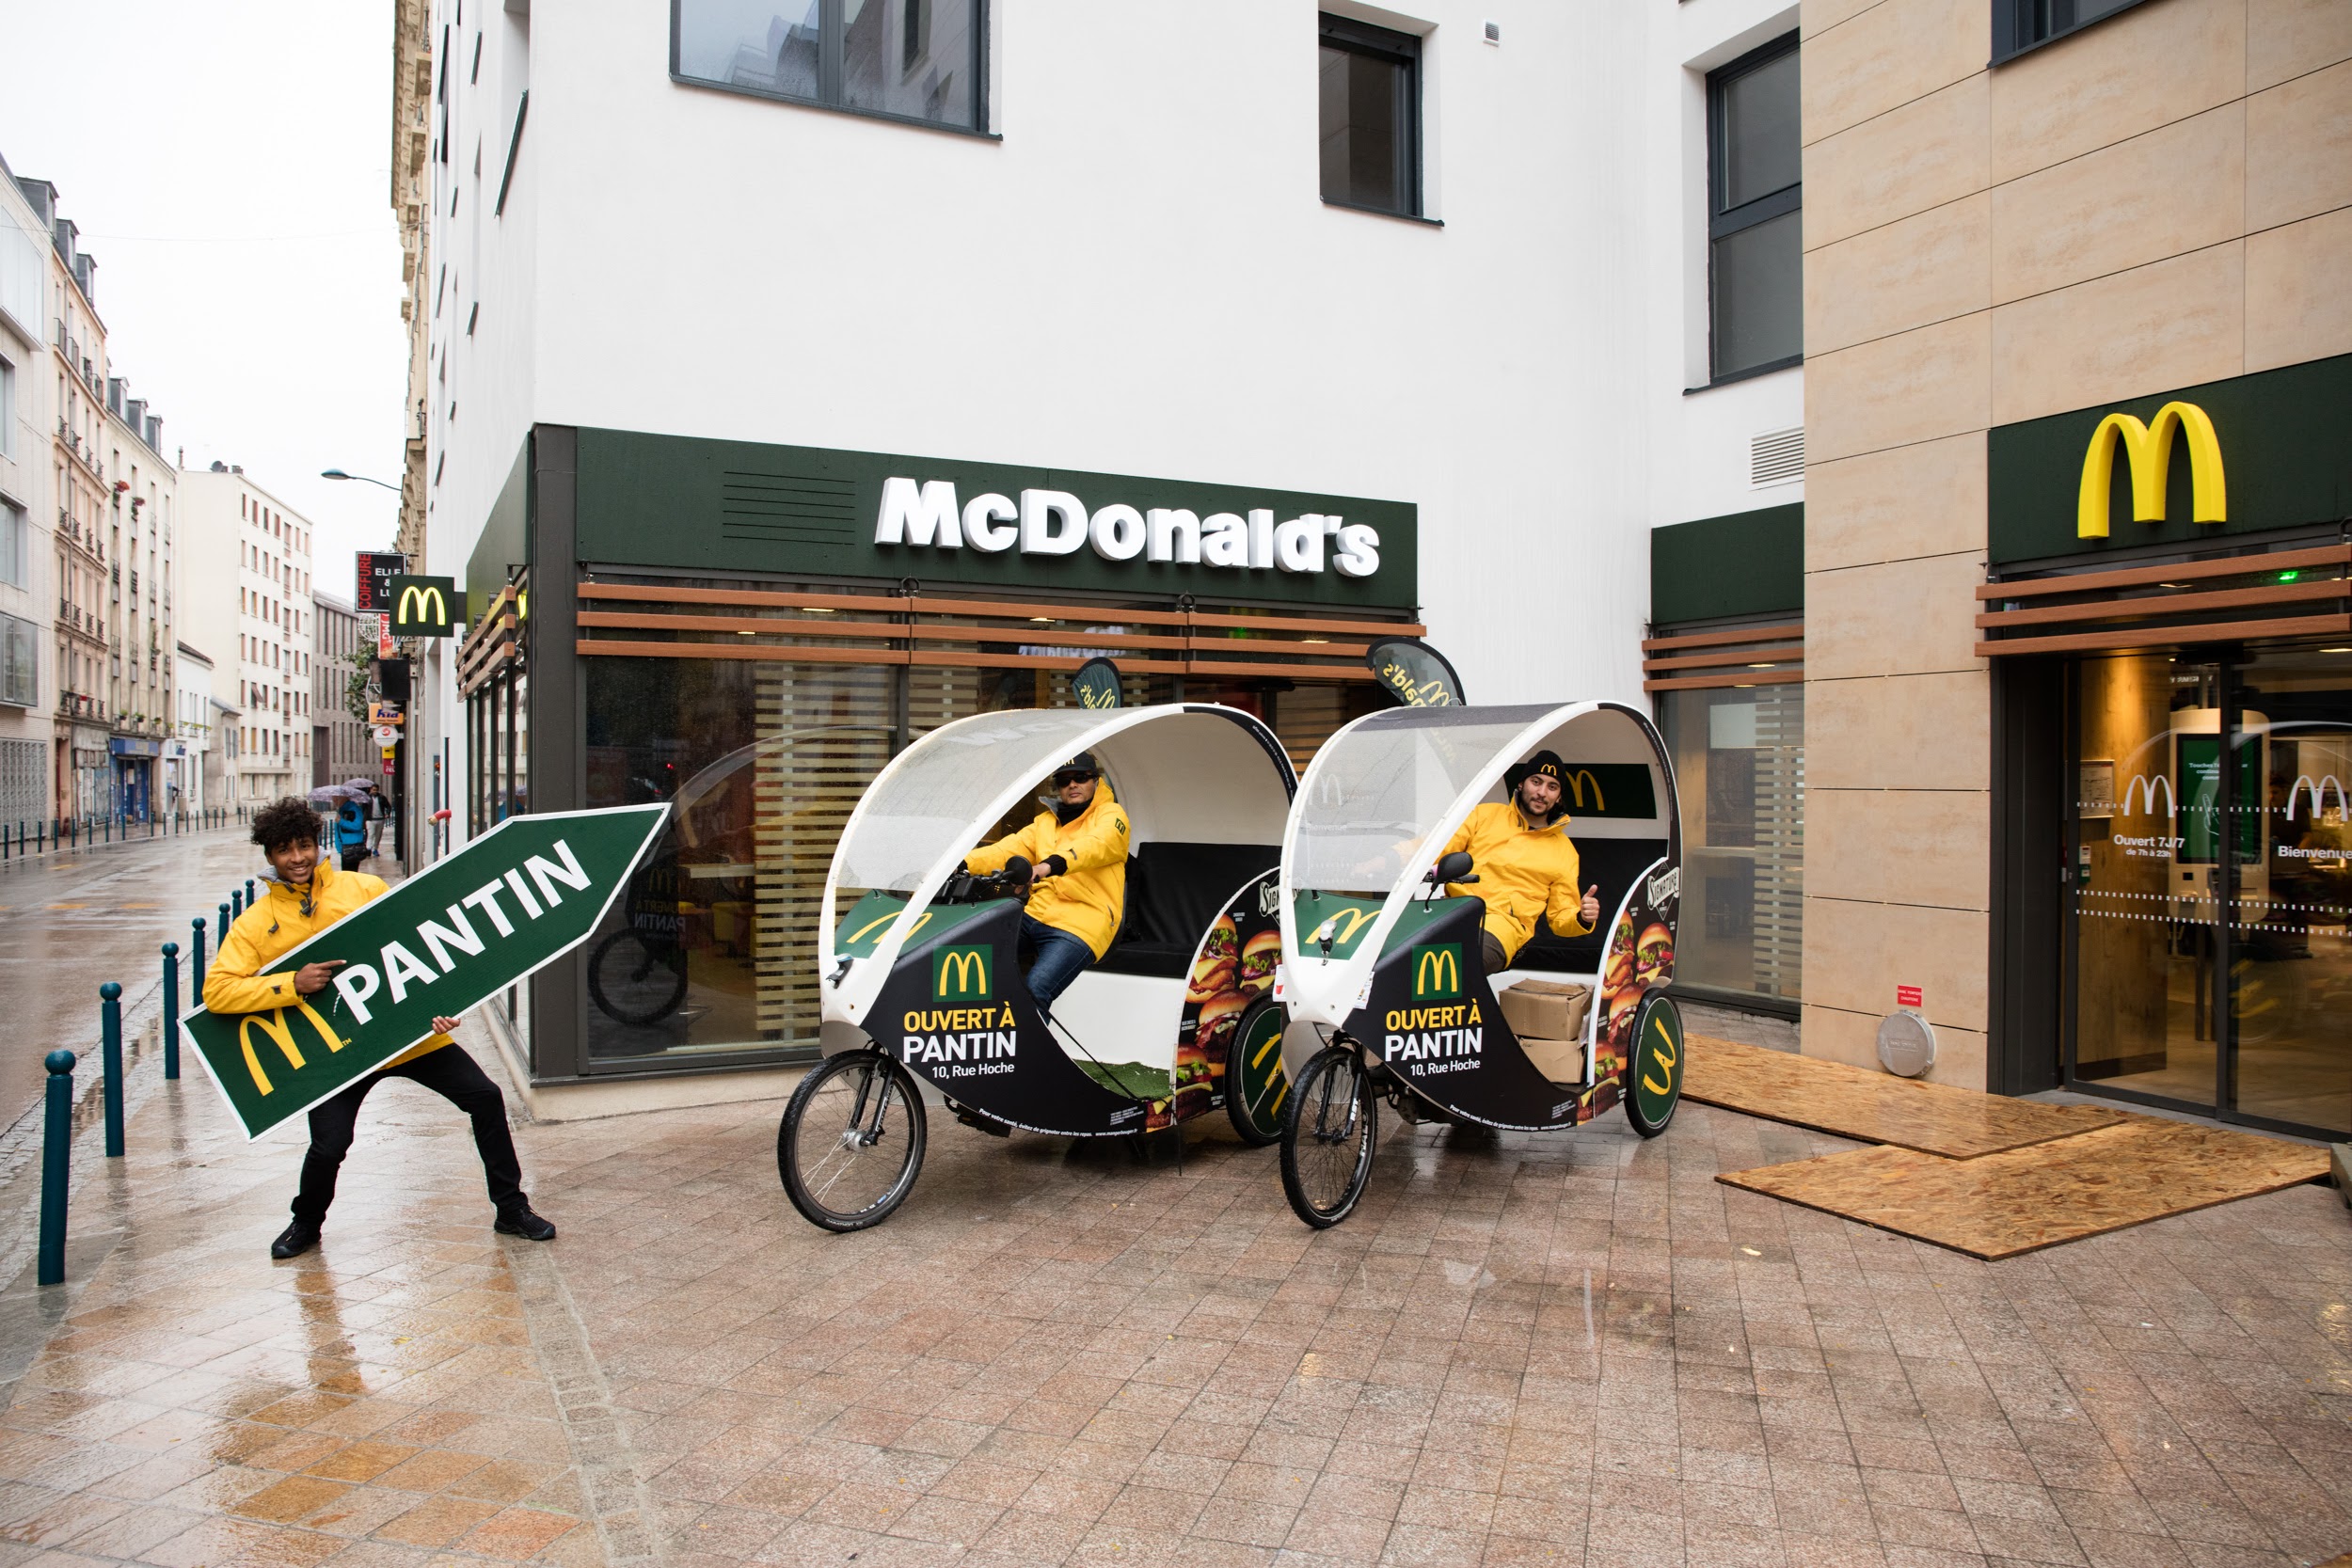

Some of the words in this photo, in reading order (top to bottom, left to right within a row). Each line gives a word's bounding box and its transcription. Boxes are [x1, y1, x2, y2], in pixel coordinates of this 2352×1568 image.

[875, 477, 1379, 578] McDonald's
[358, 553, 372, 610] COIFFURE
[2113, 833, 2155, 847] Ouvert
[2157, 836, 2185, 848] 7J/7
[2137, 848, 2148, 857] 7h
[2149, 848, 2155, 857] à
[2156, 849, 2171, 858] 23h
[2278, 845, 2352, 860] Bienvenue
[332, 838, 592, 1025] PANTIN
[903, 1007, 996, 1032] OUVERT
[998, 1001, 1016, 1028] À
[1386, 1005, 1466, 1032] OUVERT
[1468, 998, 1483, 1024] À
[903, 1031, 1017, 1064] PANTIN
[1385, 1027, 1483, 1062] PANTIN
[931, 1066, 949, 1079] 10,
[952, 1064, 976, 1077] Rue
[978, 1062, 1015, 1075] Hoche
[1410, 1064, 1426, 1077] 10,
[1427, 1062, 1448, 1074] Rue
[1450, 1058, 1481, 1071] Hoche
[979, 1108, 992, 1117] Pour
[991, 1114, 1004, 1123] votre
